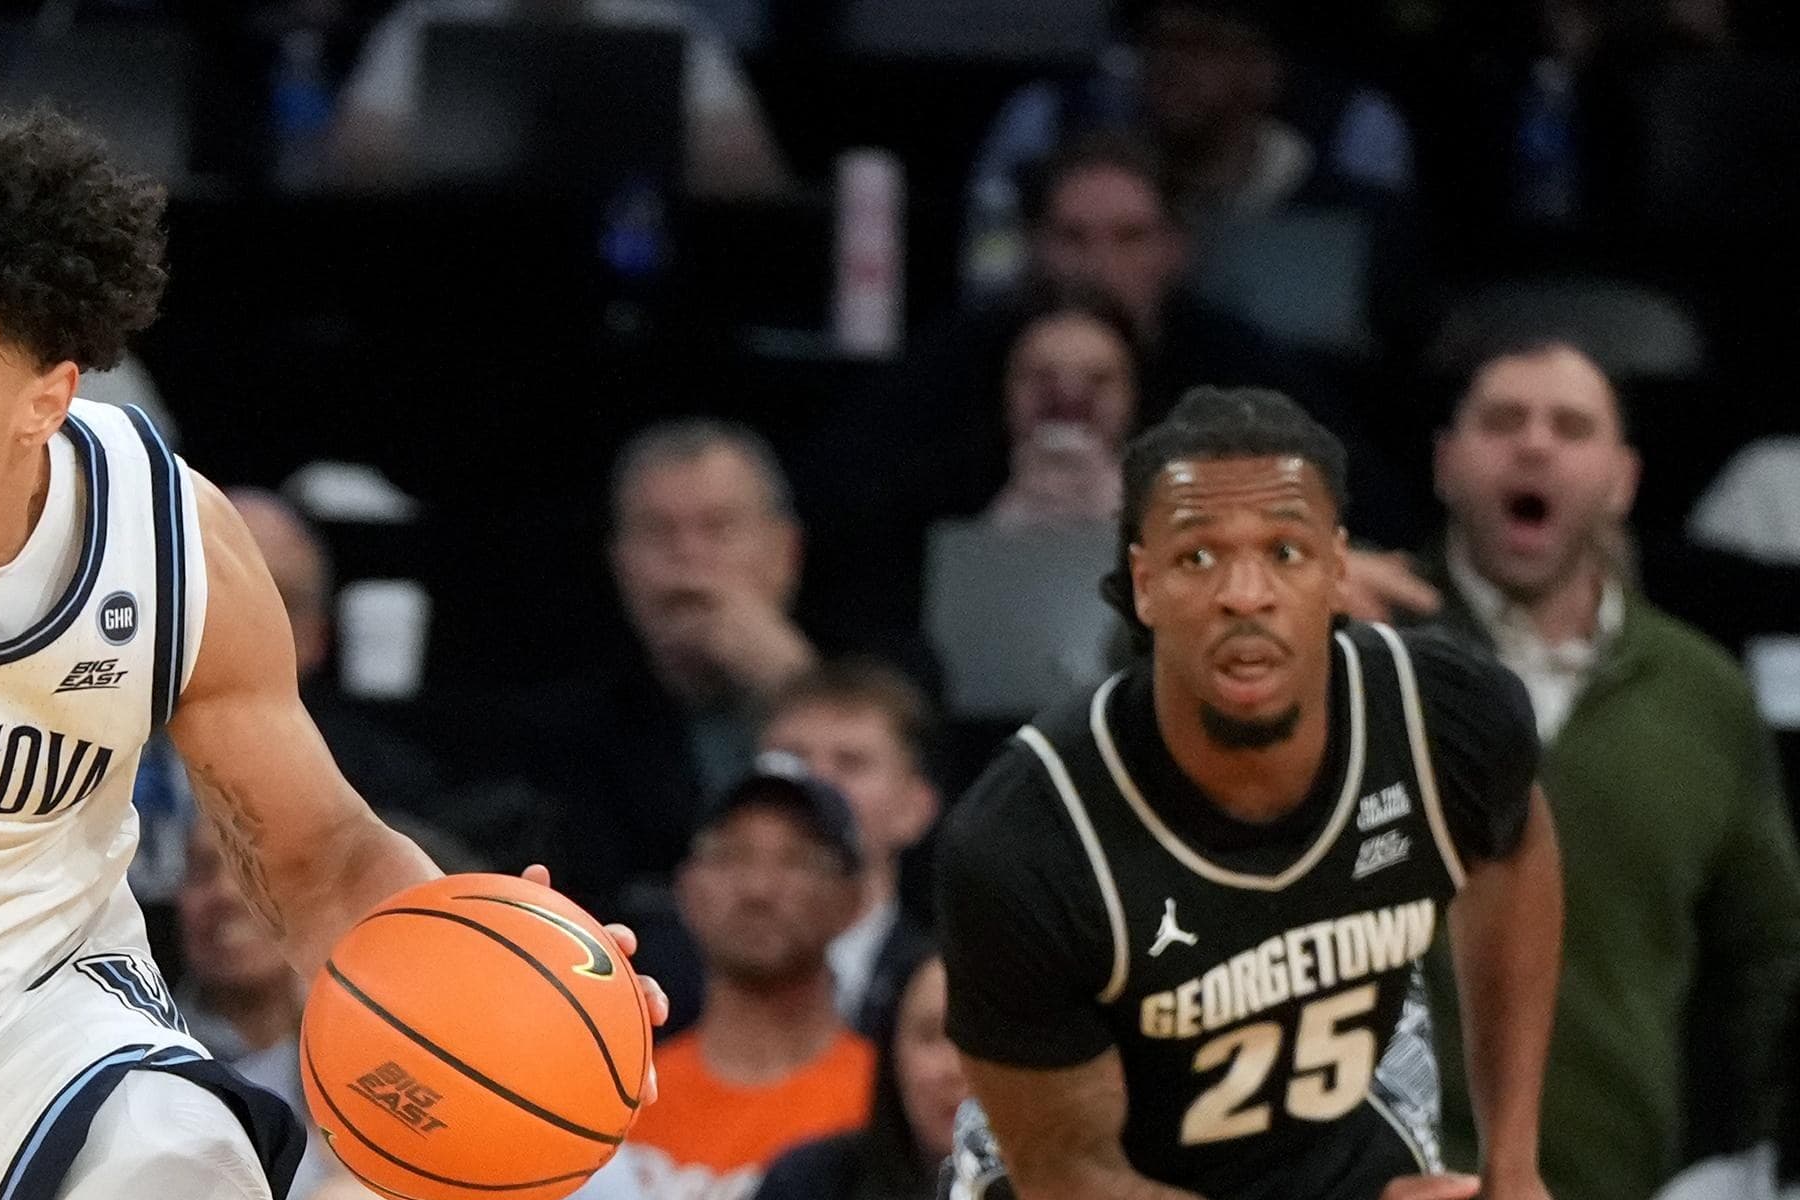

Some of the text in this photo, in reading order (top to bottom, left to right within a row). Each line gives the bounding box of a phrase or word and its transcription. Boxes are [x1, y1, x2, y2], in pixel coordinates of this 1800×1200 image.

[104, 606, 133, 630] GHR
[59, 670, 128, 687] EAST
[70, 658, 119, 674] BIG
[1140, 897, 1436, 1039] GEORGETOWN
[374, 1060, 443, 1109] BIG
[1179, 981, 1378, 1147] 25
[356, 1072, 449, 1132] EAST
